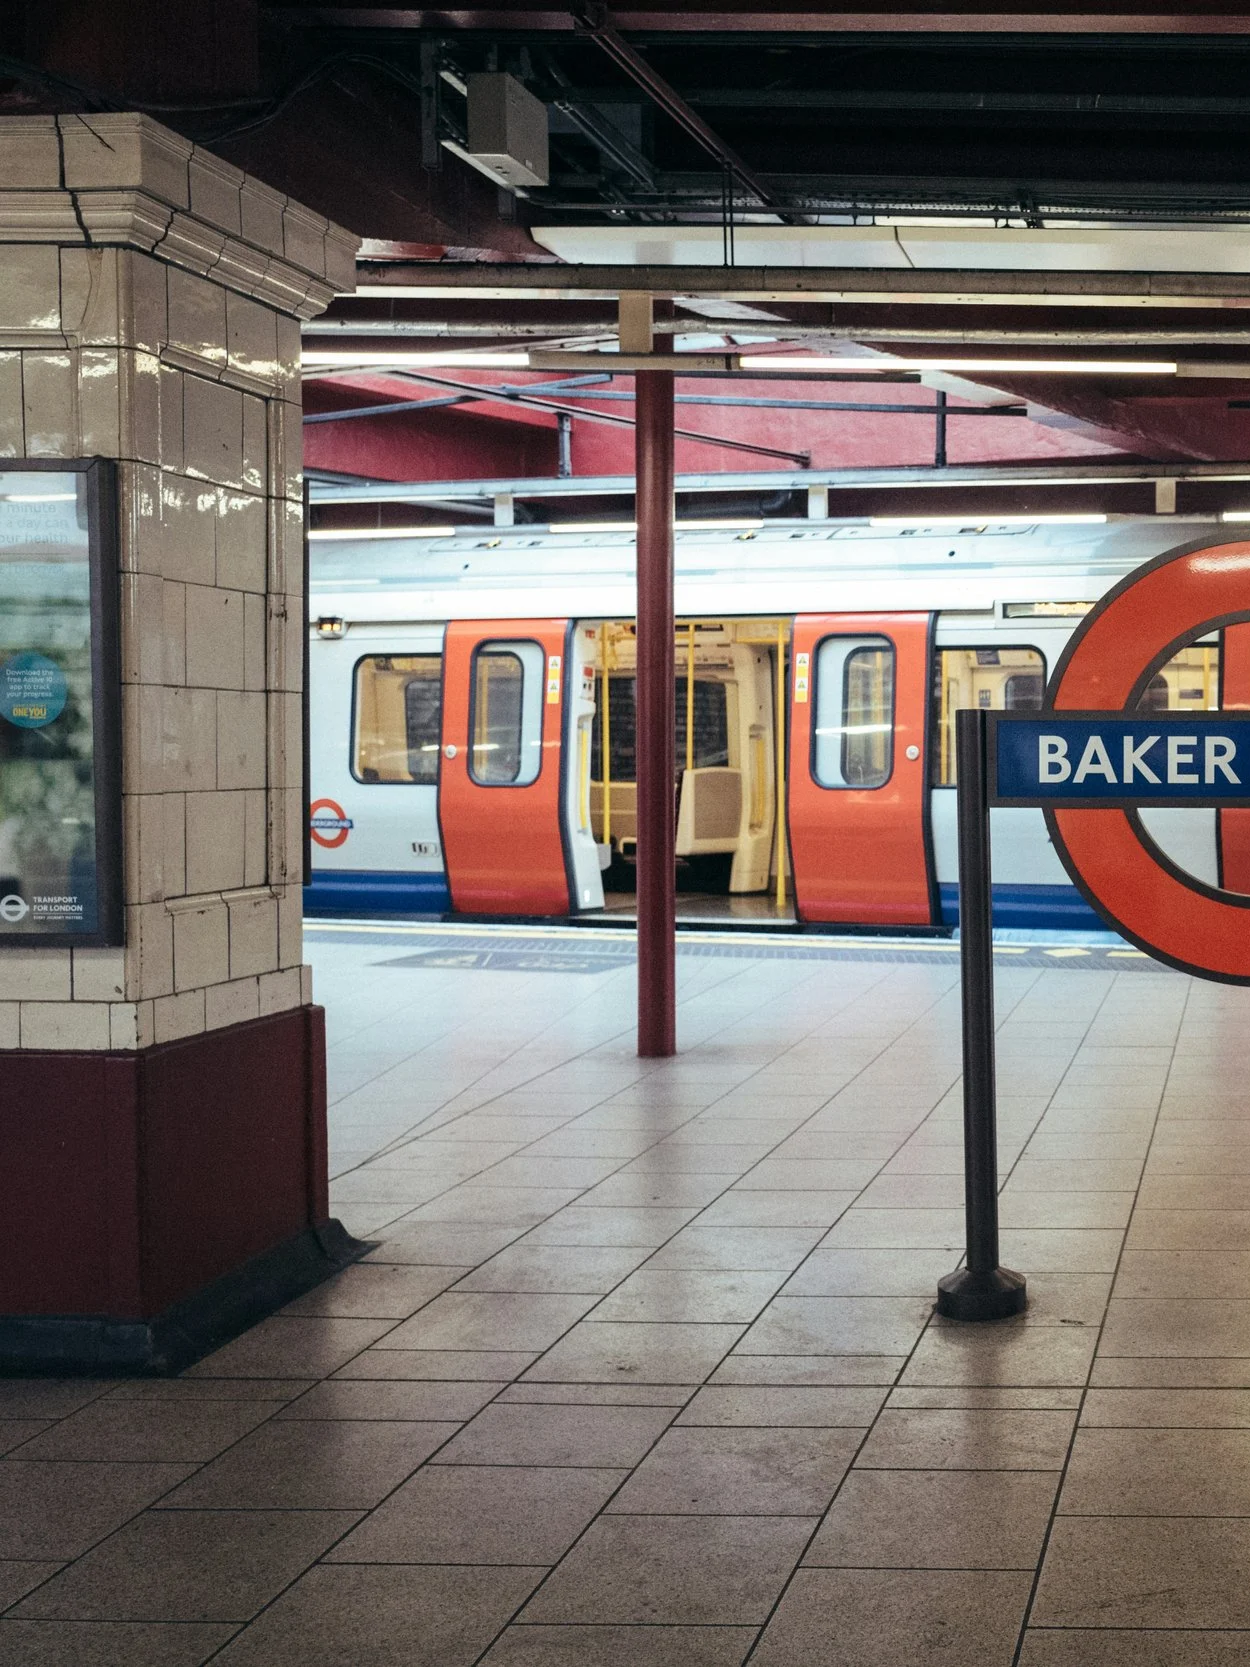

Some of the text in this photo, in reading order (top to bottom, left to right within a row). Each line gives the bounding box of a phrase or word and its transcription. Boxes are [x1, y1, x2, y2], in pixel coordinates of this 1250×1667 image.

[7, 504, 57, 513] minute
[17, 518, 41, 530] day
[45, 520, 70, 528] can
[0, 532, 68, 543] our health
[1038, 735, 1242, 784] BAKER
